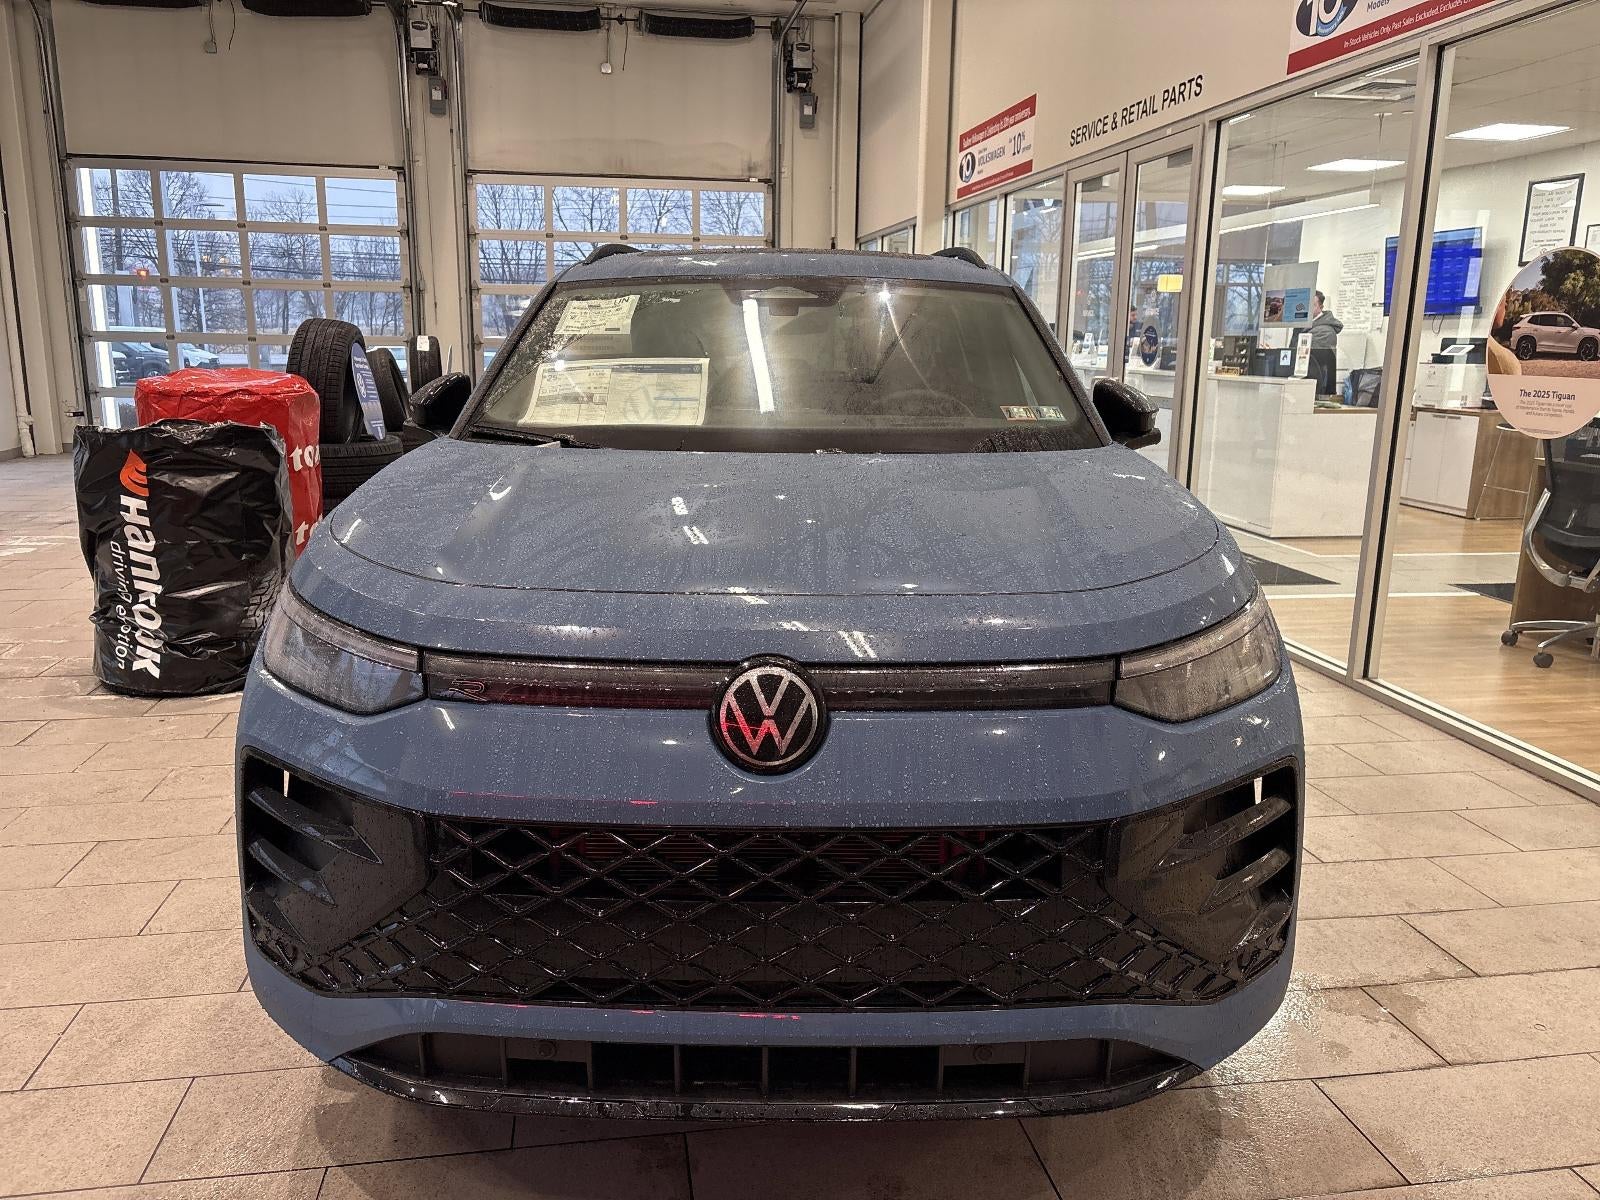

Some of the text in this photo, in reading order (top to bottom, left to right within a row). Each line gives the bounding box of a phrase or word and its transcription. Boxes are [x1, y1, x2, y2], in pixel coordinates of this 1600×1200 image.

[1367, 0, 1389, 12] Models
[1070, 74, 1203, 147] SERVICE & RETAIL PARTS
[1520, 389, 1576, 402] The 2025 Tiguan
[110, 540, 133, 604] driving
[120, 494, 162, 679] Hankook
